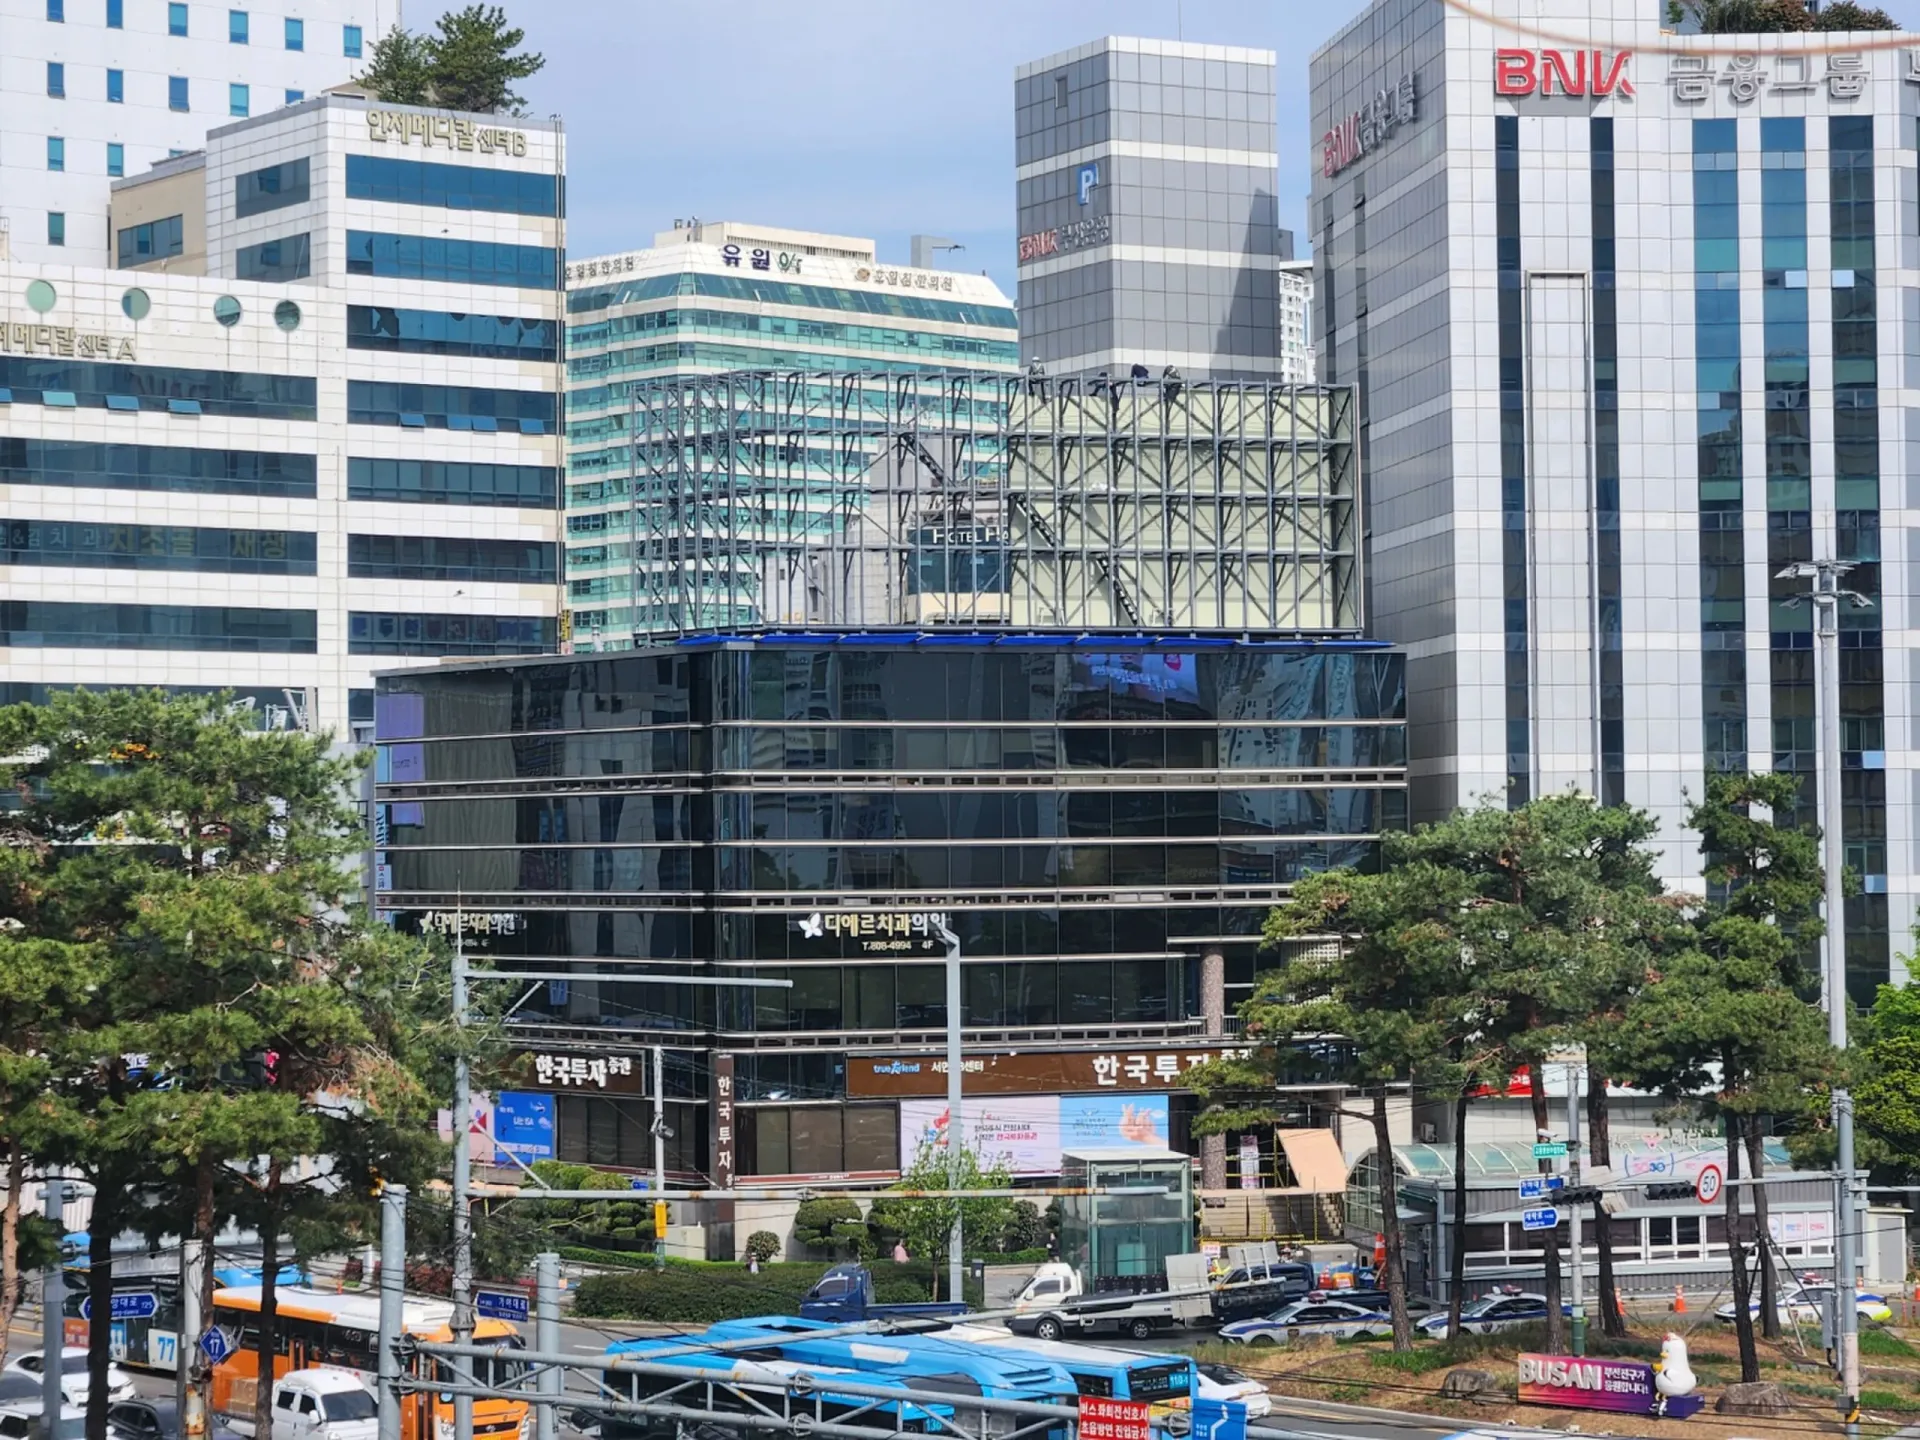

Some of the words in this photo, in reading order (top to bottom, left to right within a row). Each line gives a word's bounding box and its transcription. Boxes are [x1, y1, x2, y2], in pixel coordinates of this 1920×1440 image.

[1497, 48, 1636, 97] BNK
[1669, 50, 1872, 102] 금융그룹
[1323, 110, 1363, 178] BNK
[1078, 166, 1096, 203] P
[722, 244, 770, 271] 유원
[1020, 229, 1058, 260] BNK
[933, 528, 983, 544] HOTEL
[717, 1076, 733, 1190] 한국투자증
[1703, 1175, 1716, 1192] 50
[110, 1297, 137, 1310] 앙대로
[498, 1296, 526, 1310] 가야대로
[156, 1336, 176, 1362] 77
[208, 1339, 222, 1355] 17
[1519, 1359, 1601, 1390] BUSAN
